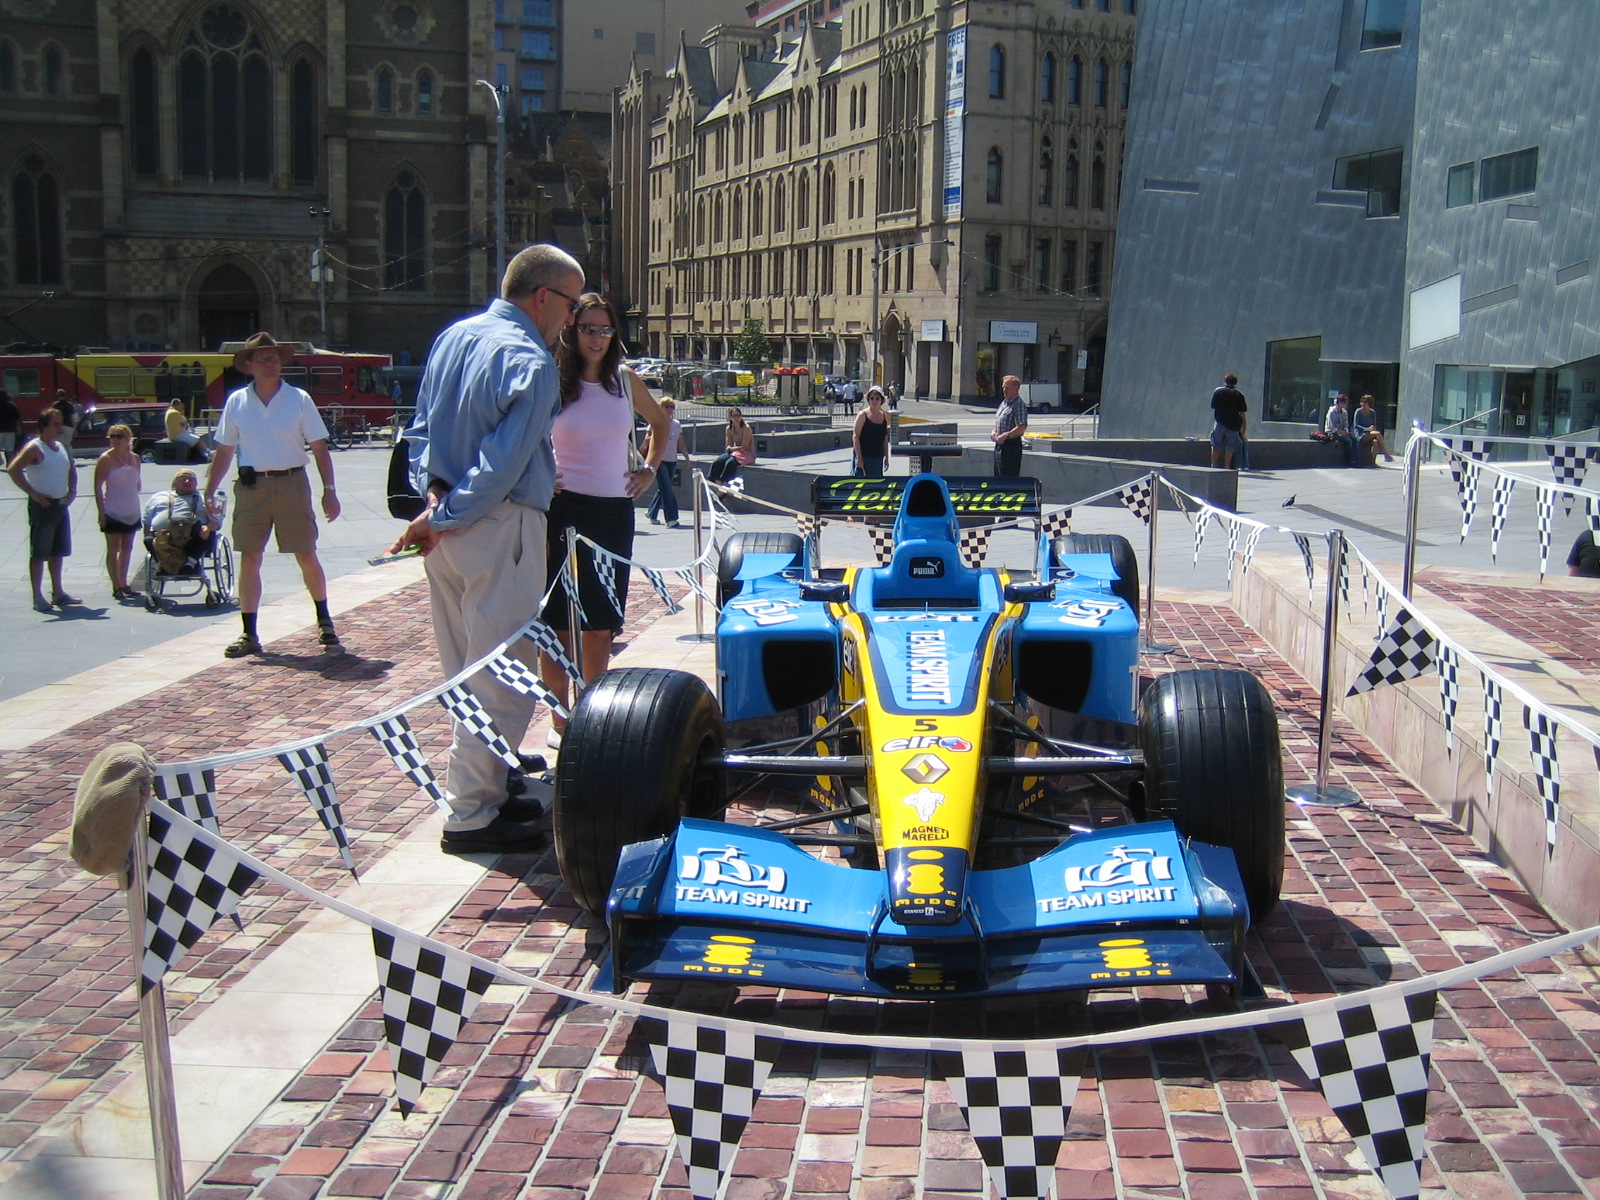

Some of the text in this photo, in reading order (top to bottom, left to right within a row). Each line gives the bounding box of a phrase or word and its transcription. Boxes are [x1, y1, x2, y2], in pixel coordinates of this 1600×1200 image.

[947, 30, 965, 47] FREE
[913, 567, 935, 575] PUMA
[909, 629, 952, 704] TEAM SPIRIT
[913, 719, 938, 732] 5
[675, 886, 811, 913] TEAM SPIRIT
[1037, 886, 1176, 912] TEAM SPIRIT
